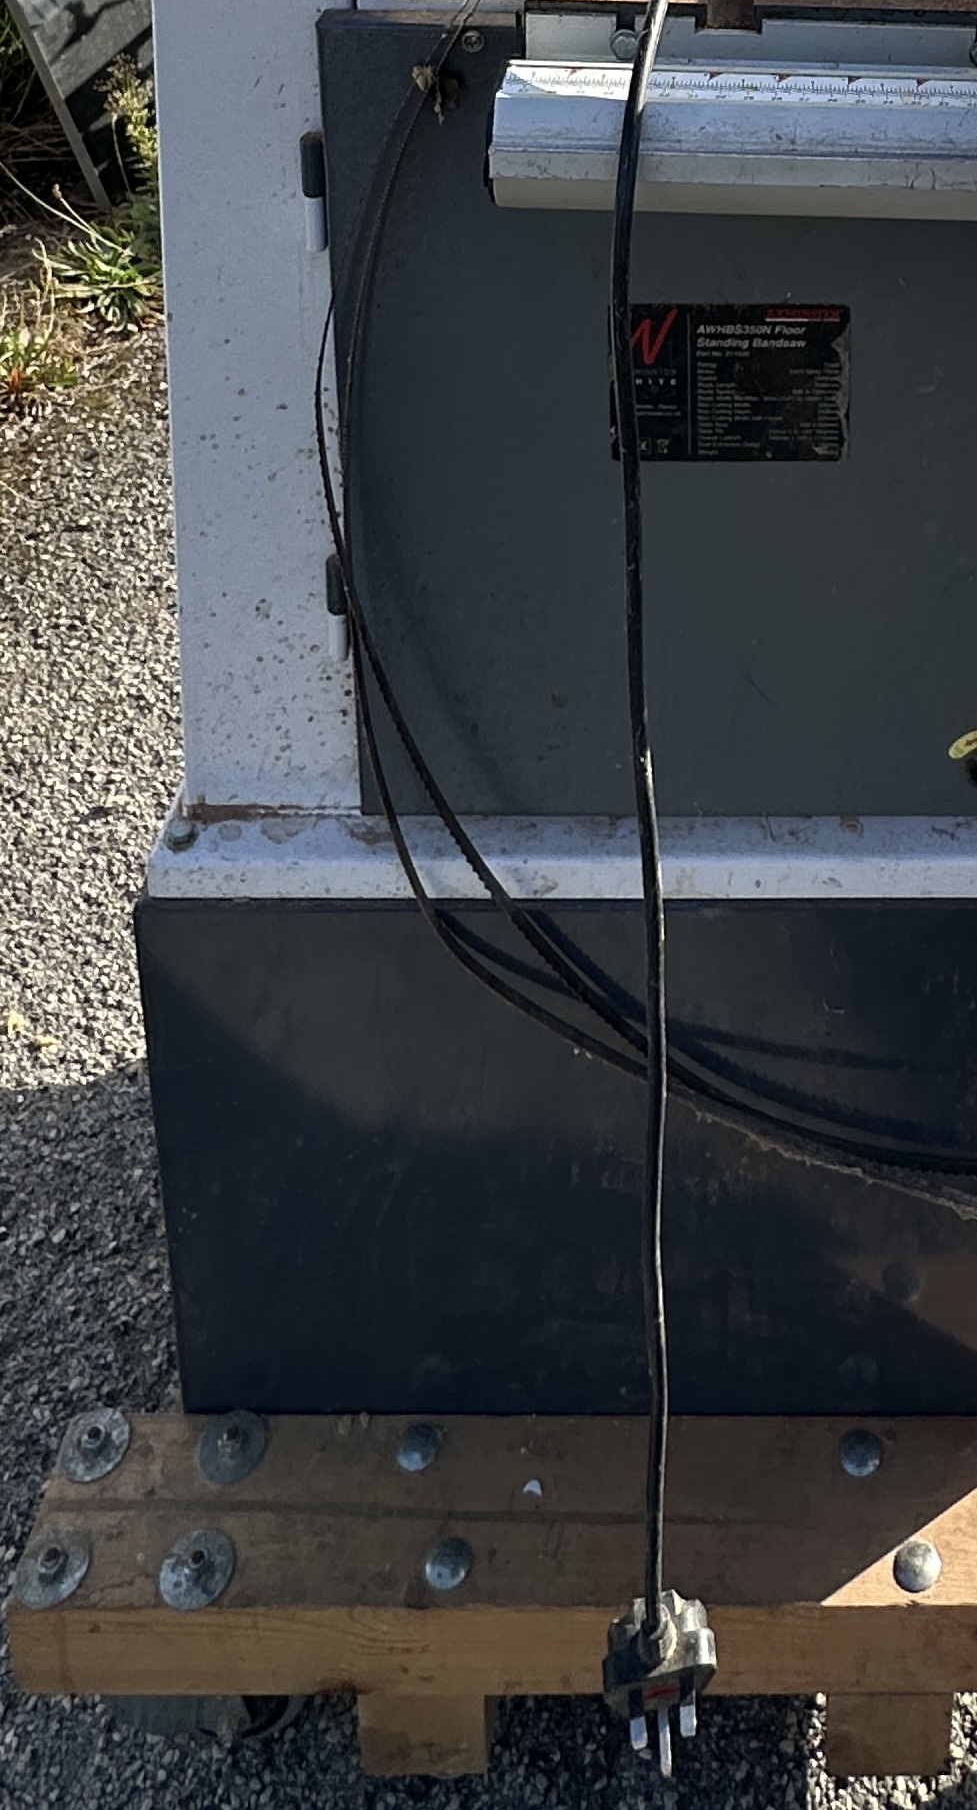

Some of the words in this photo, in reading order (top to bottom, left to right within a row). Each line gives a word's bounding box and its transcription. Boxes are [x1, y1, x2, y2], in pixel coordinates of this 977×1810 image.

[774, 324, 807, 336] Floor
[696, 337, 750, 350] Standing
[752, 338, 807, 349] Bandsaw
